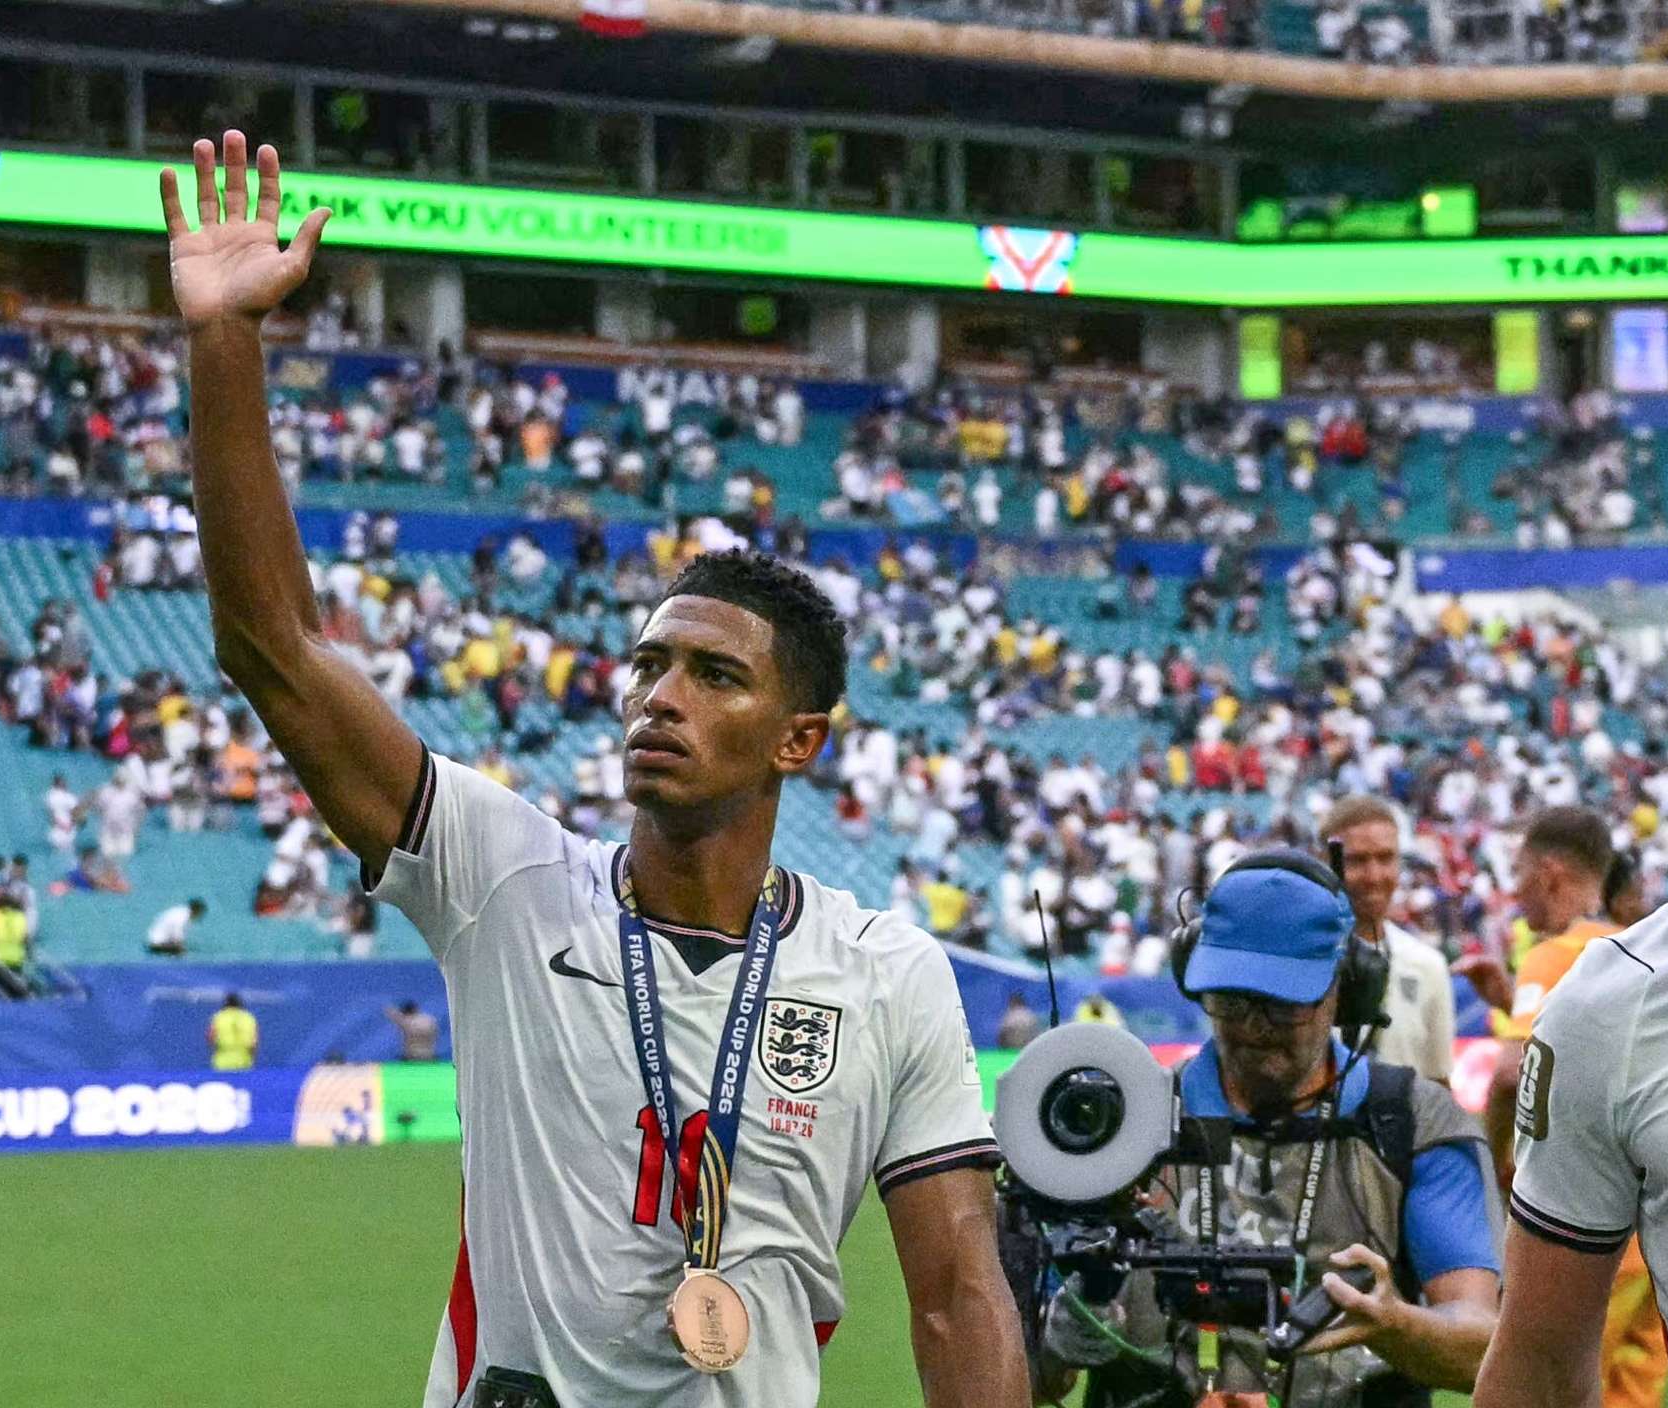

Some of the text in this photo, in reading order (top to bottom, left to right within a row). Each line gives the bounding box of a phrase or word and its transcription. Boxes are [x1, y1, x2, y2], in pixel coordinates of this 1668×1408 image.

[381, 198, 467, 232] YOU
[627, 934, 670, 1137] FIFA WORLD CUP 2026
[718, 921, 772, 1115] FIFA WORLD CUP 2026
[767, 1097, 818, 1120] FRANCE
